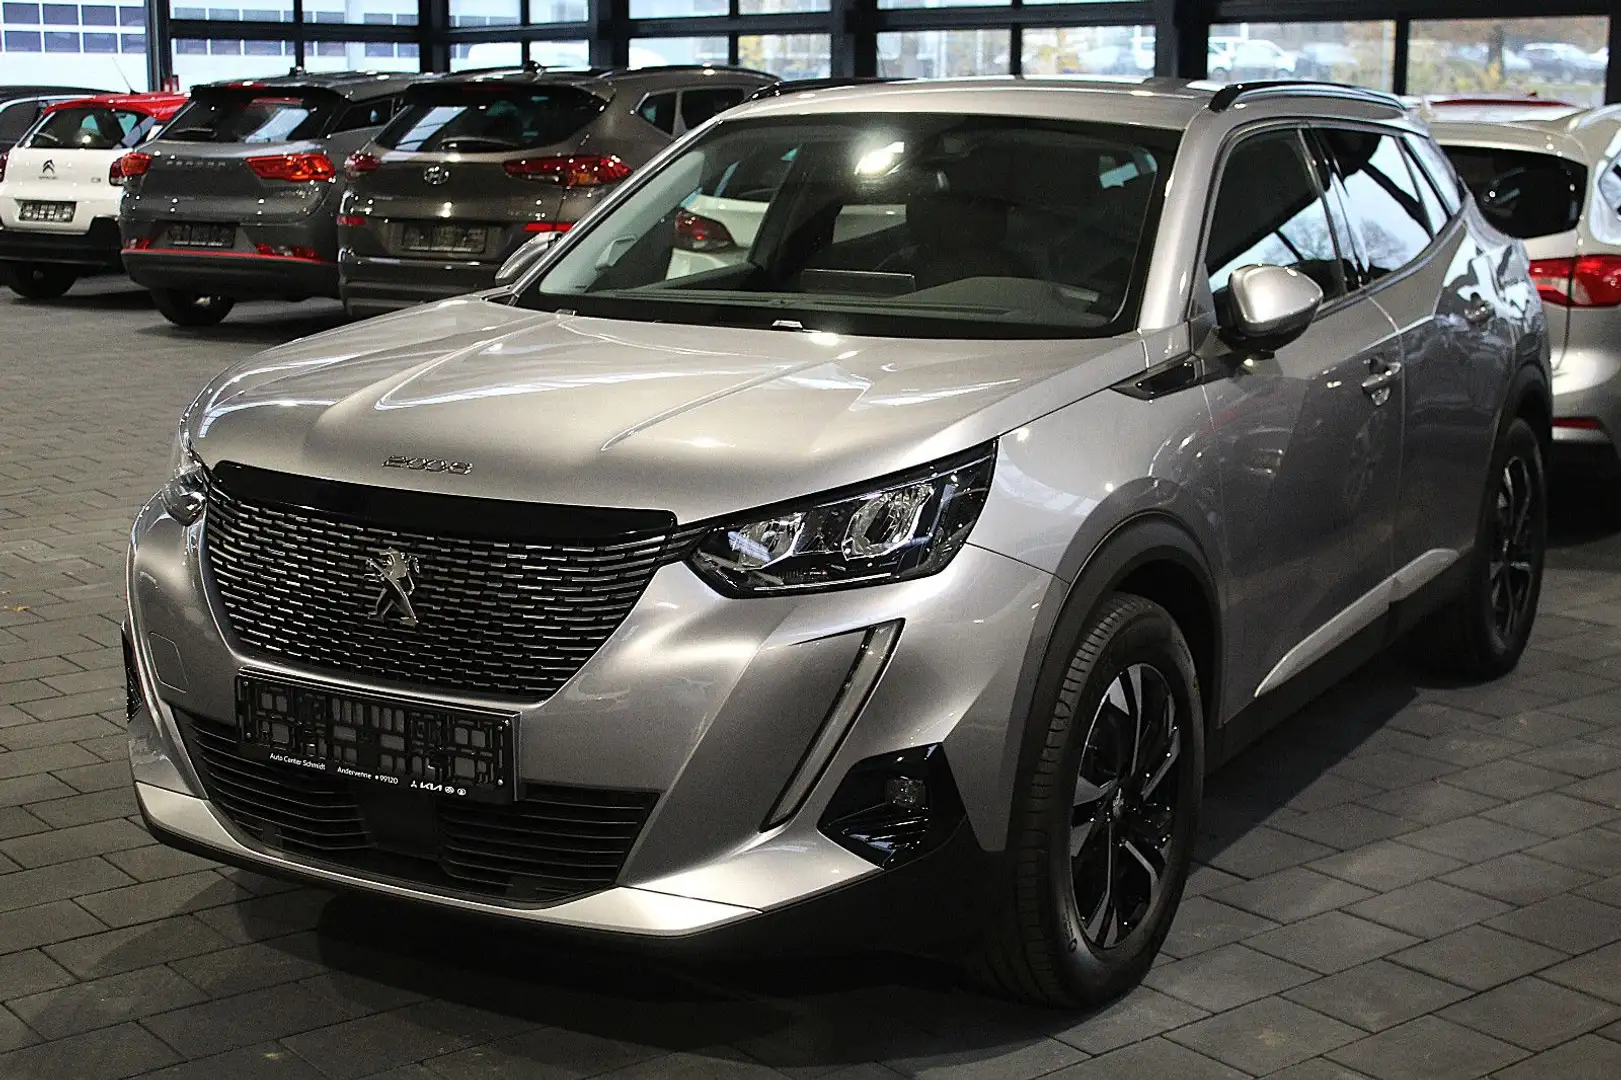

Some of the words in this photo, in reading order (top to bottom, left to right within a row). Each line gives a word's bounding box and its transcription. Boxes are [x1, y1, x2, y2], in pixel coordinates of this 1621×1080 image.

[382, 455, 472, 475] 2008
[269, 752, 283, 762] Auto
[283, 756, 302, 766] Center
[302, 760, 326, 771] Schmidt
[337, 766, 372, 779] Andervenne
